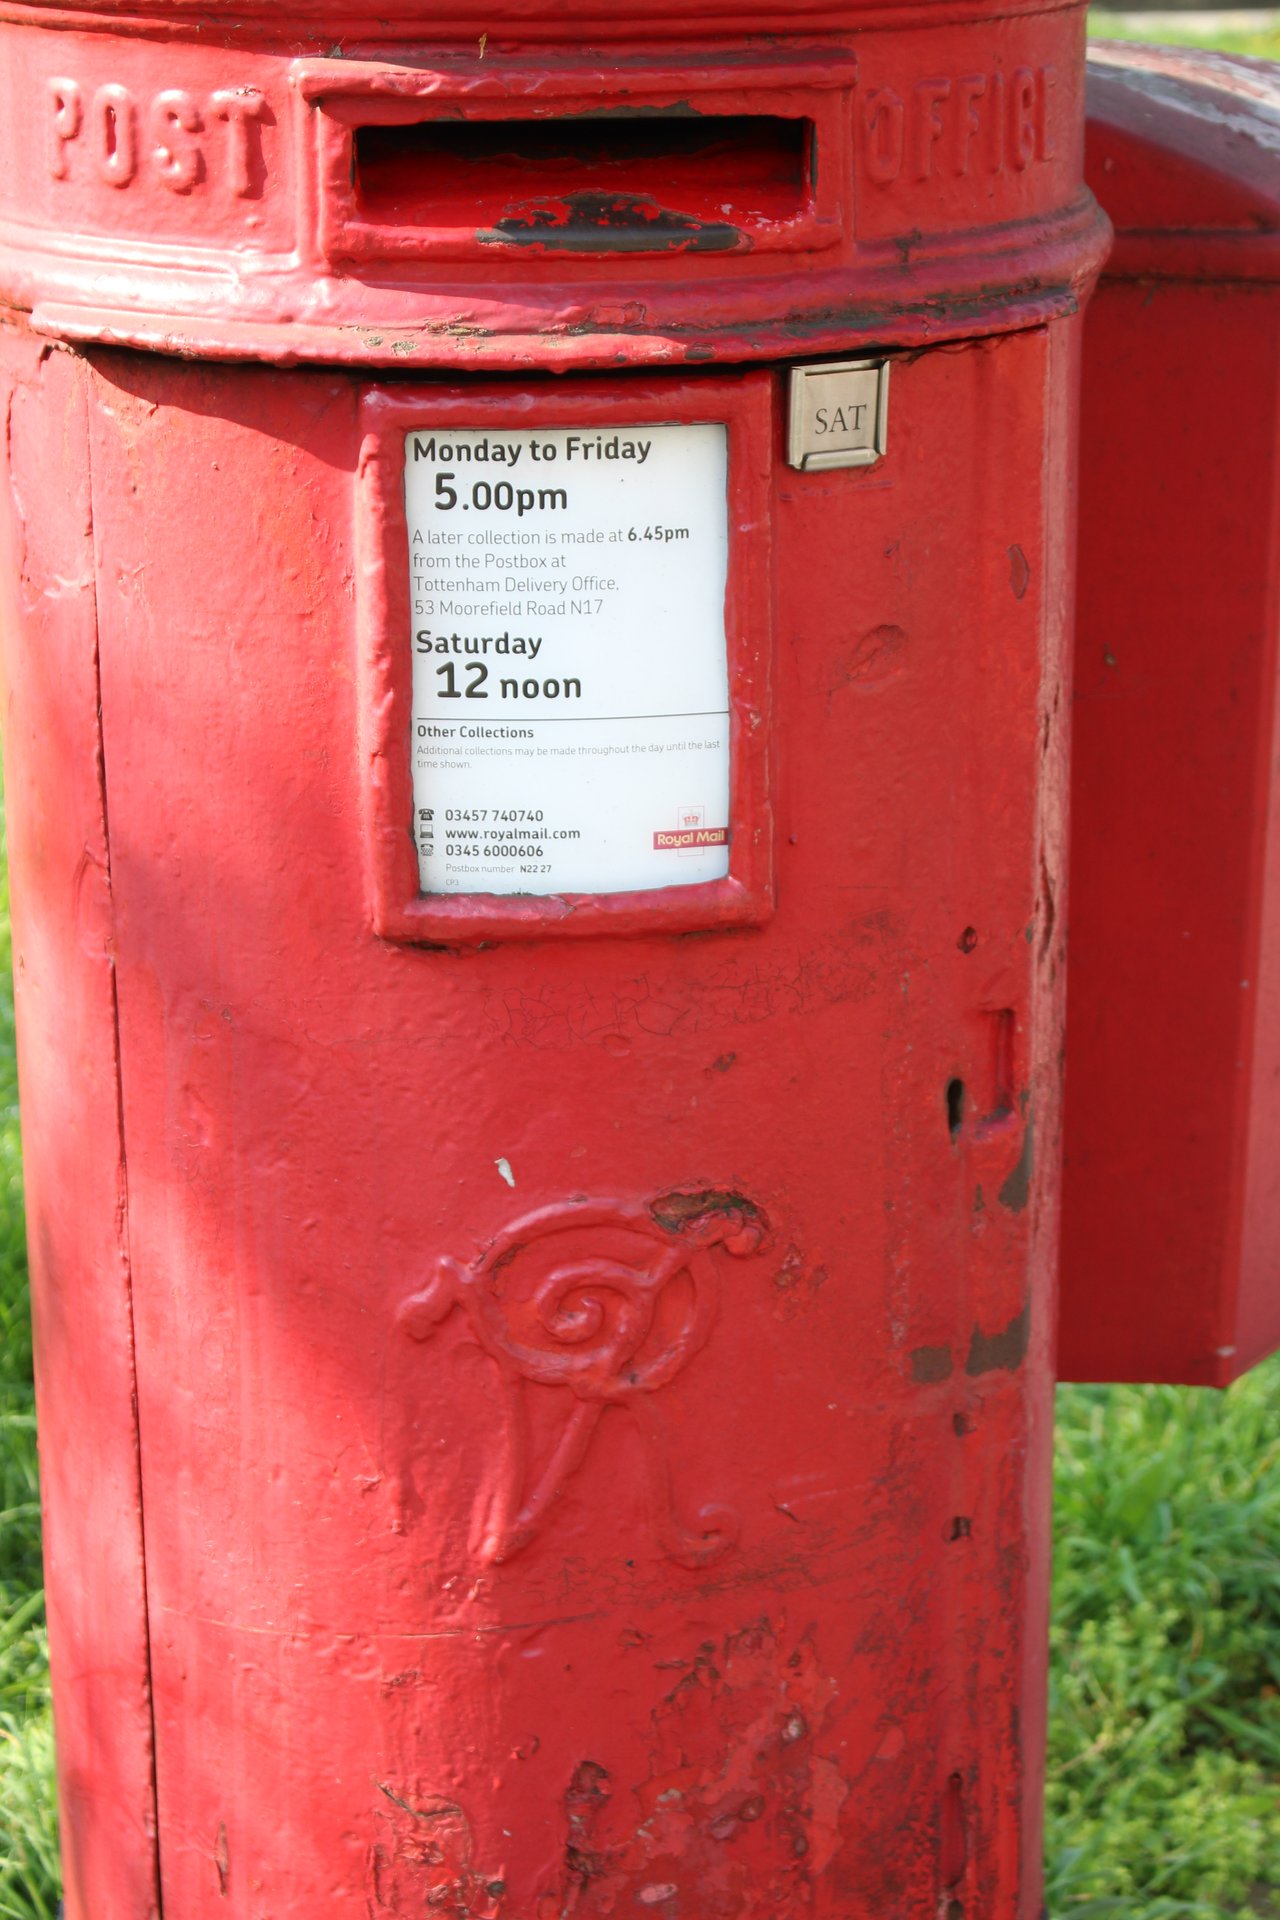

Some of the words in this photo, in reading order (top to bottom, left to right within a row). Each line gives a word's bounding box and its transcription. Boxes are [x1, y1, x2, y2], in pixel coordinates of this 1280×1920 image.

[48, 77, 272, 199] POST
[864, 64, 1057, 190] OFFICE
[815, 403, 867, 435] SAT
[414, 437, 522, 467] Monday
[530, 437, 557, 462] to
[566, 435, 652, 463] Friday
[434, 471, 568, 517] 5.00pm
[412, 528, 423, 544] A
[427, 530, 462, 545] later
[467, 530, 540, 545] collection
[545, 530, 556, 544] is
[561, 528, 605, 544] made
[609, 528, 623, 543] at
[627, 526, 689, 544] 6.45pm
[413, 553, 451, 569] from
[455, 553, 480, 569] the
[485, 553, 547, 569] Postbox
[551, 554, 566, 568] at
[414, 576, 500, 593] Tottenham
[506, 576, 567, 595] Delivery
[415, 599, 434, 616] 53
[439, 599, 522, 616] Moorefield
[527, 599, 565, 616] Road
[570, 599, 603, 615] N17
[416, 630, 542, 660] Saturday
[436, 661, 488, 699] 12
[500, 676, 582, 699] noon
[417, 725, 456, 738] Other
[459, 725, 534, 739] Collections
[417, 745, 462, 756] Additional
[465, 745, 512, 756] collections
[515, 746, 535, 757] may
[537, 745, 548, 755] be
[550, 745, 576, 755] made
[578, 744, 629, 757] throughout
[632, 743, 646, 754] the
[648, 742, 664, 756] day
[666, 741, 686, 752] until
[688, 740, 702, 750] the
[704, 739, 720, 749] last
[417, 759, 438, 769] time
[445, 809, 488, 822] 03457
[492, 809, 544, 822] 740740
[446, 827, 581, 842] www.royalmail.com
[657, 832, 694, 847] Royal
[696, 830, 725, 843] Mail
[446, 844, 479, 857] 0345
[483, 845, 544, 857] 6000606
[446, 864, 479, 873] Postbox
[482, 864, 514, 873] number
